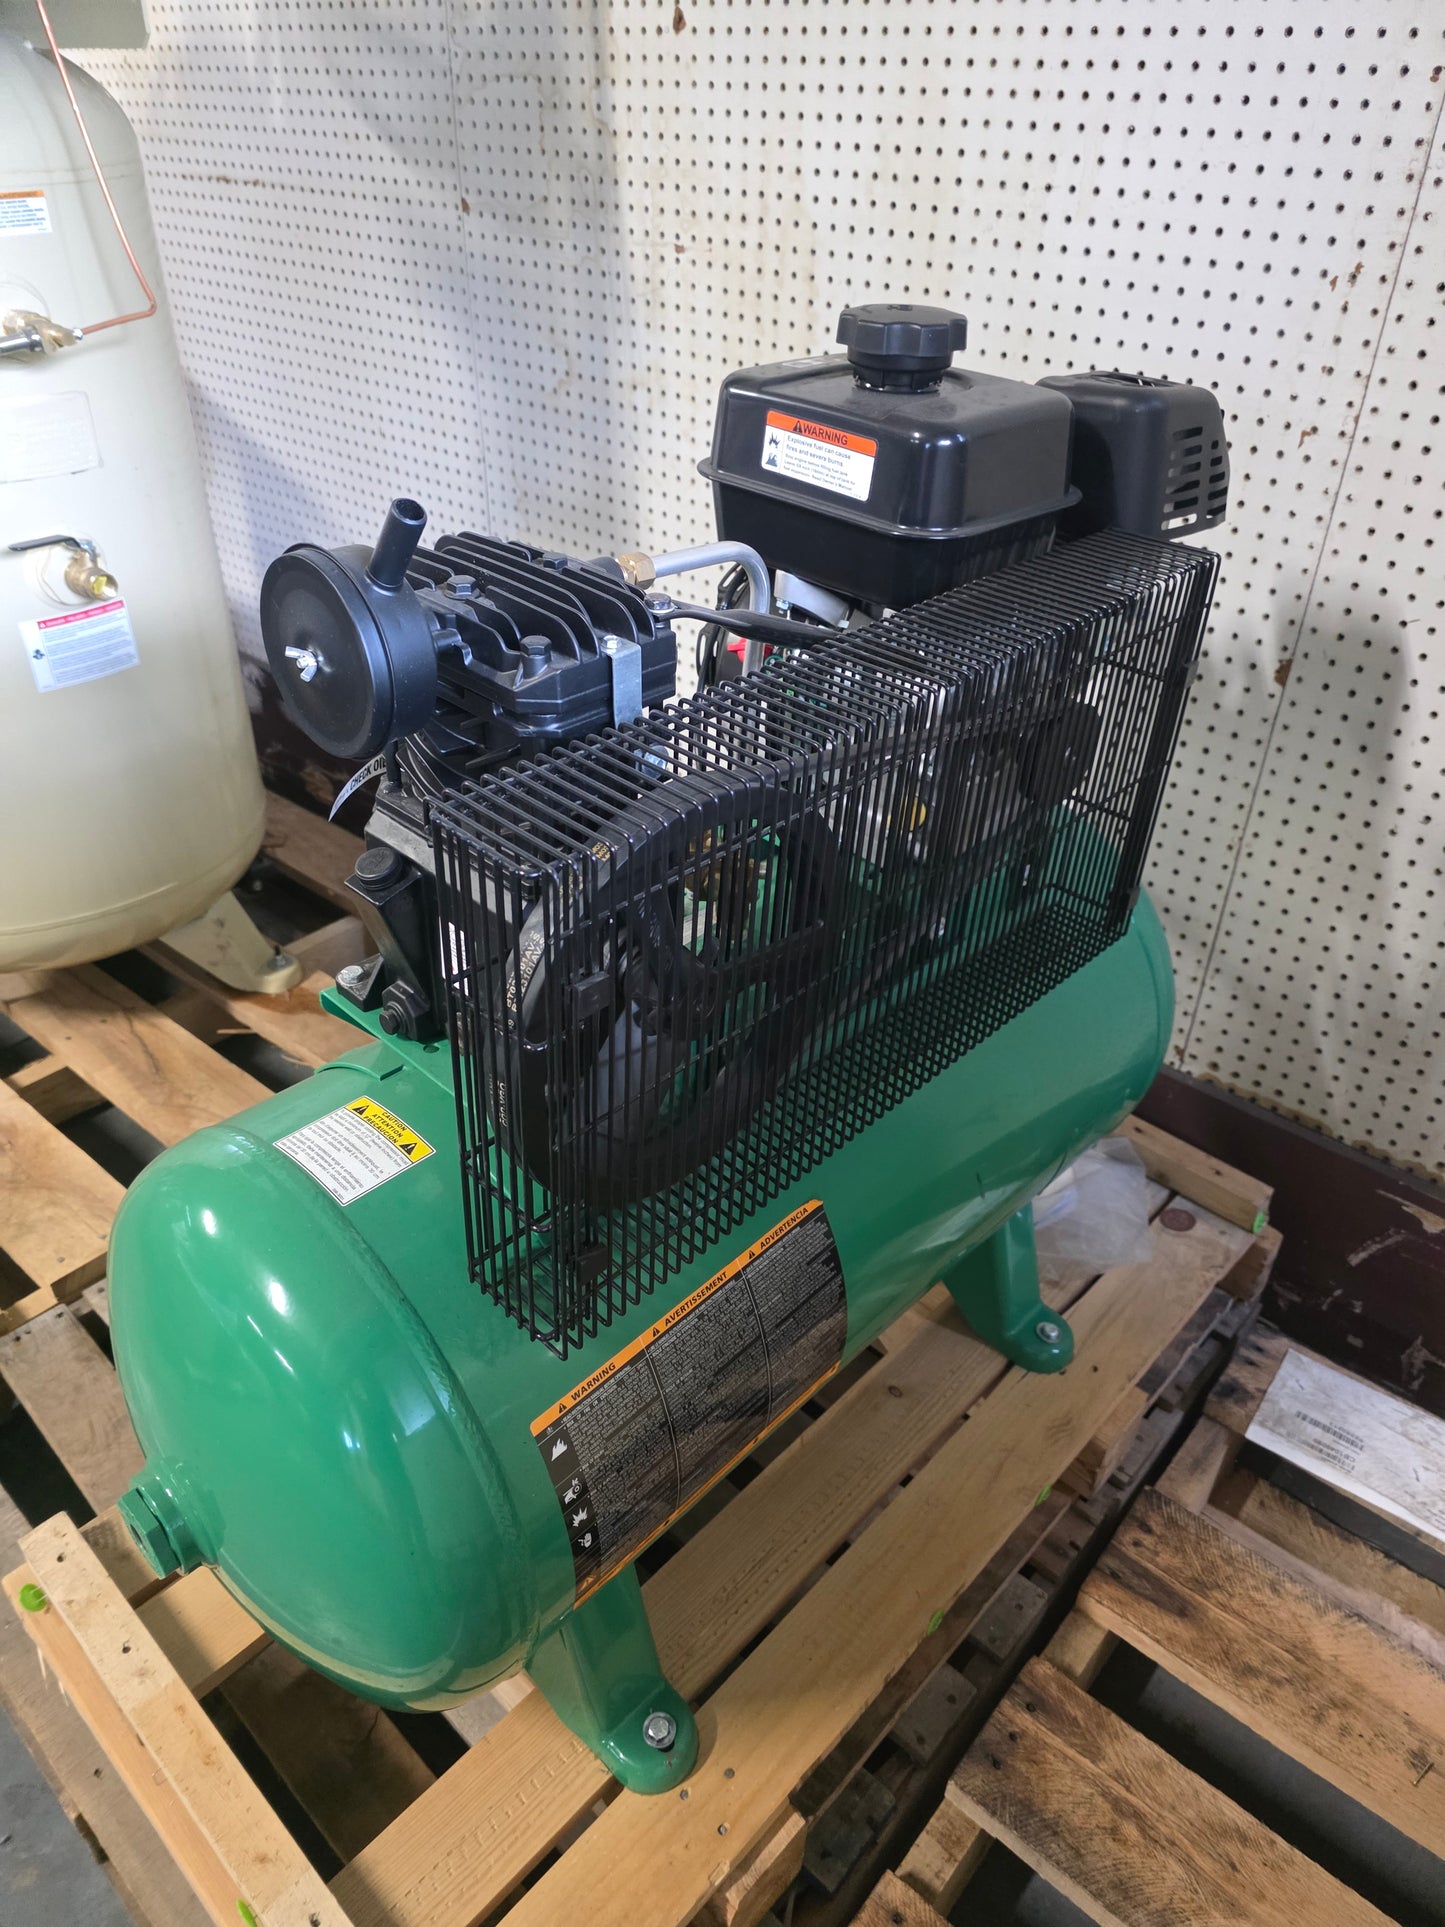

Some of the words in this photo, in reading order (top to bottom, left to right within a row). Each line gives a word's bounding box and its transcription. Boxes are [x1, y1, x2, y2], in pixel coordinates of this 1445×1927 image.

[788, 435, 812, 447] Explosive
[814, 443, 823, 451] fuel
[835, 451, 851, 459] cause
[803, 423, 848, 446] WARNING
[786, 444, 798, 452] fires
[799, 448, 809, 456] and
[810, 453, 827, 461] severe
[349, 763, 372, 791] CHECK
[372, 1113, 404, 1138] ATTENTION
[382, 1111, 407, 1131] CAUTION
[759, 1206, 809, 1250] ADVERTENCIA
[663, 1271, 728, 1327] AVERTISSEMENT
[571, 1362, 616, 1401] WARNING
